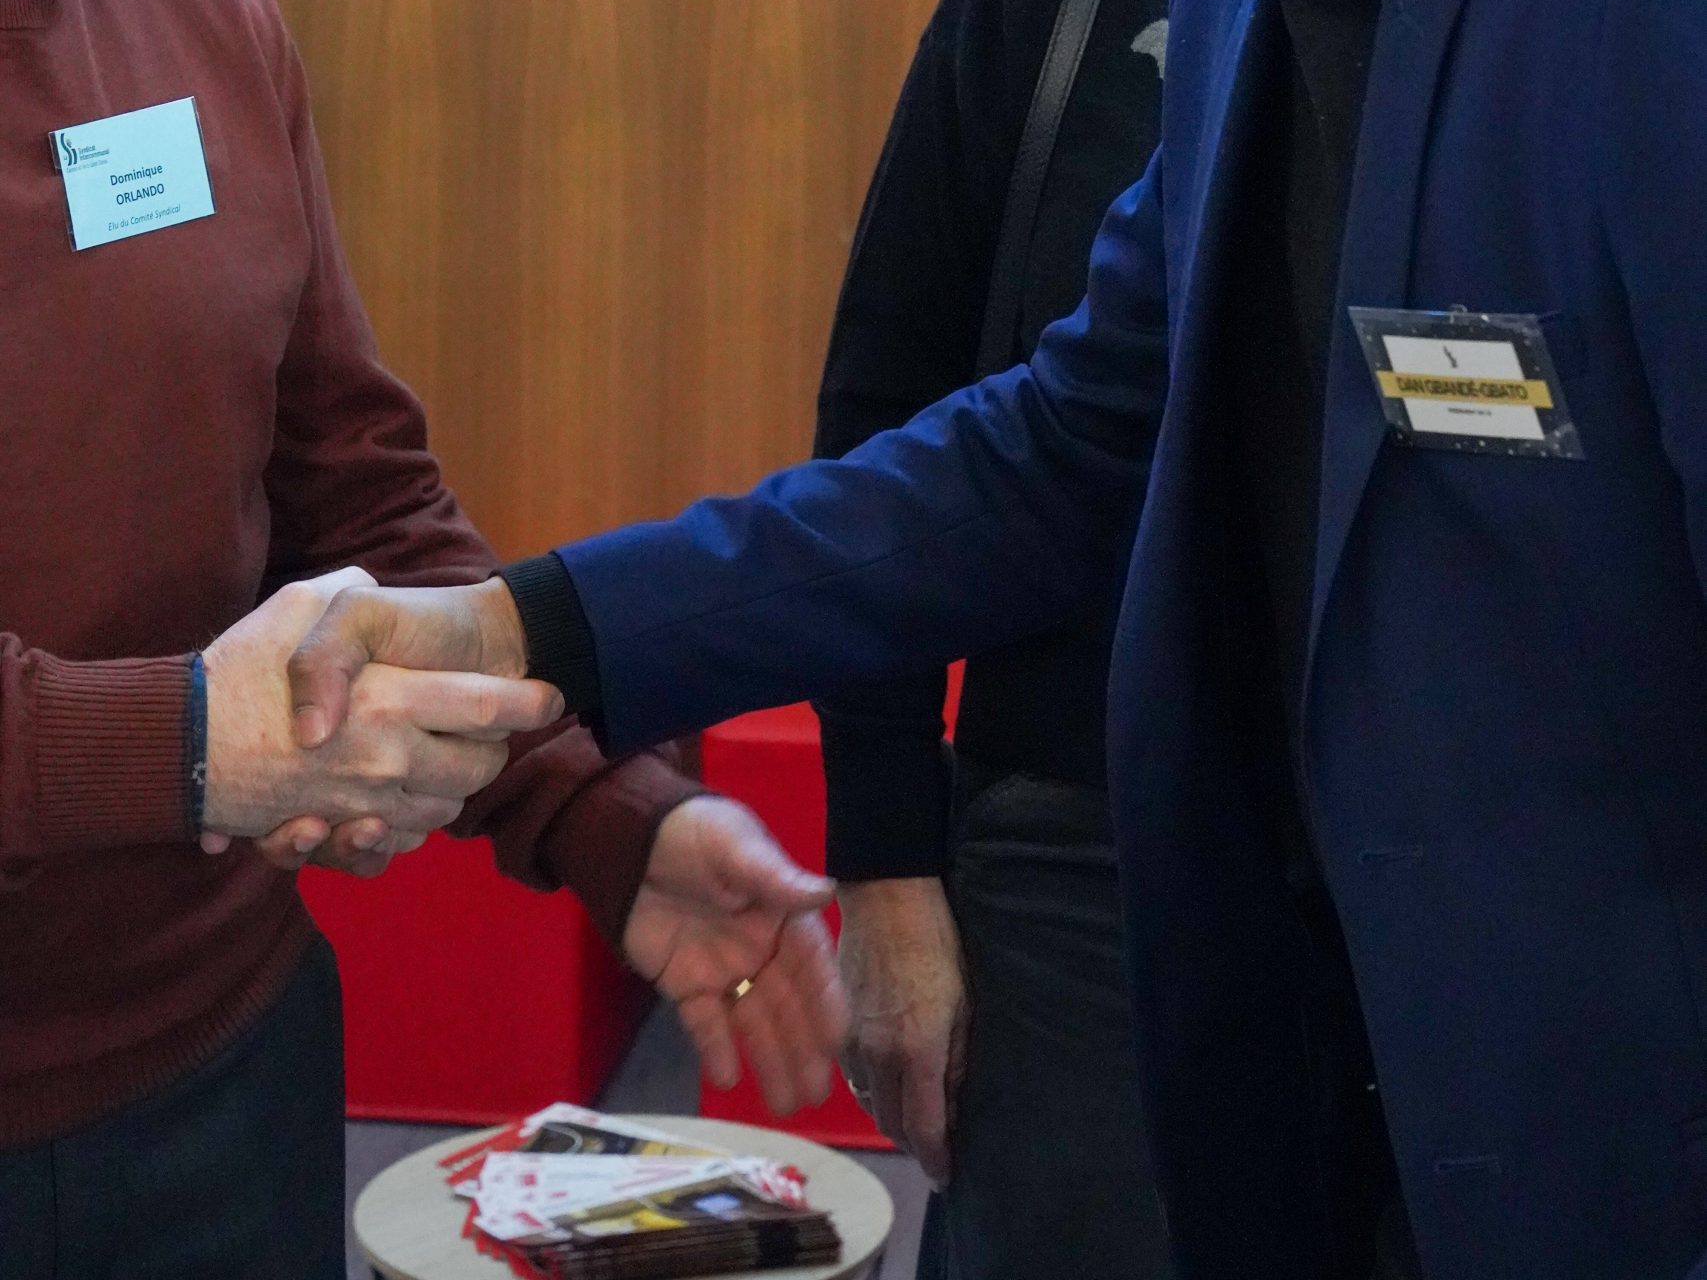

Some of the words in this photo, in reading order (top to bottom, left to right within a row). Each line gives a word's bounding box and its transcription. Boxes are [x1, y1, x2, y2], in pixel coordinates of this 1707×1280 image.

[109, 165, 164, 186] Dominique
[115, 183, 166, 206] ORLANDO
[120, 219, 130, 228] du
[130, 211, 154, 225] Comité
[154, 204, 181, 220] Syndical
